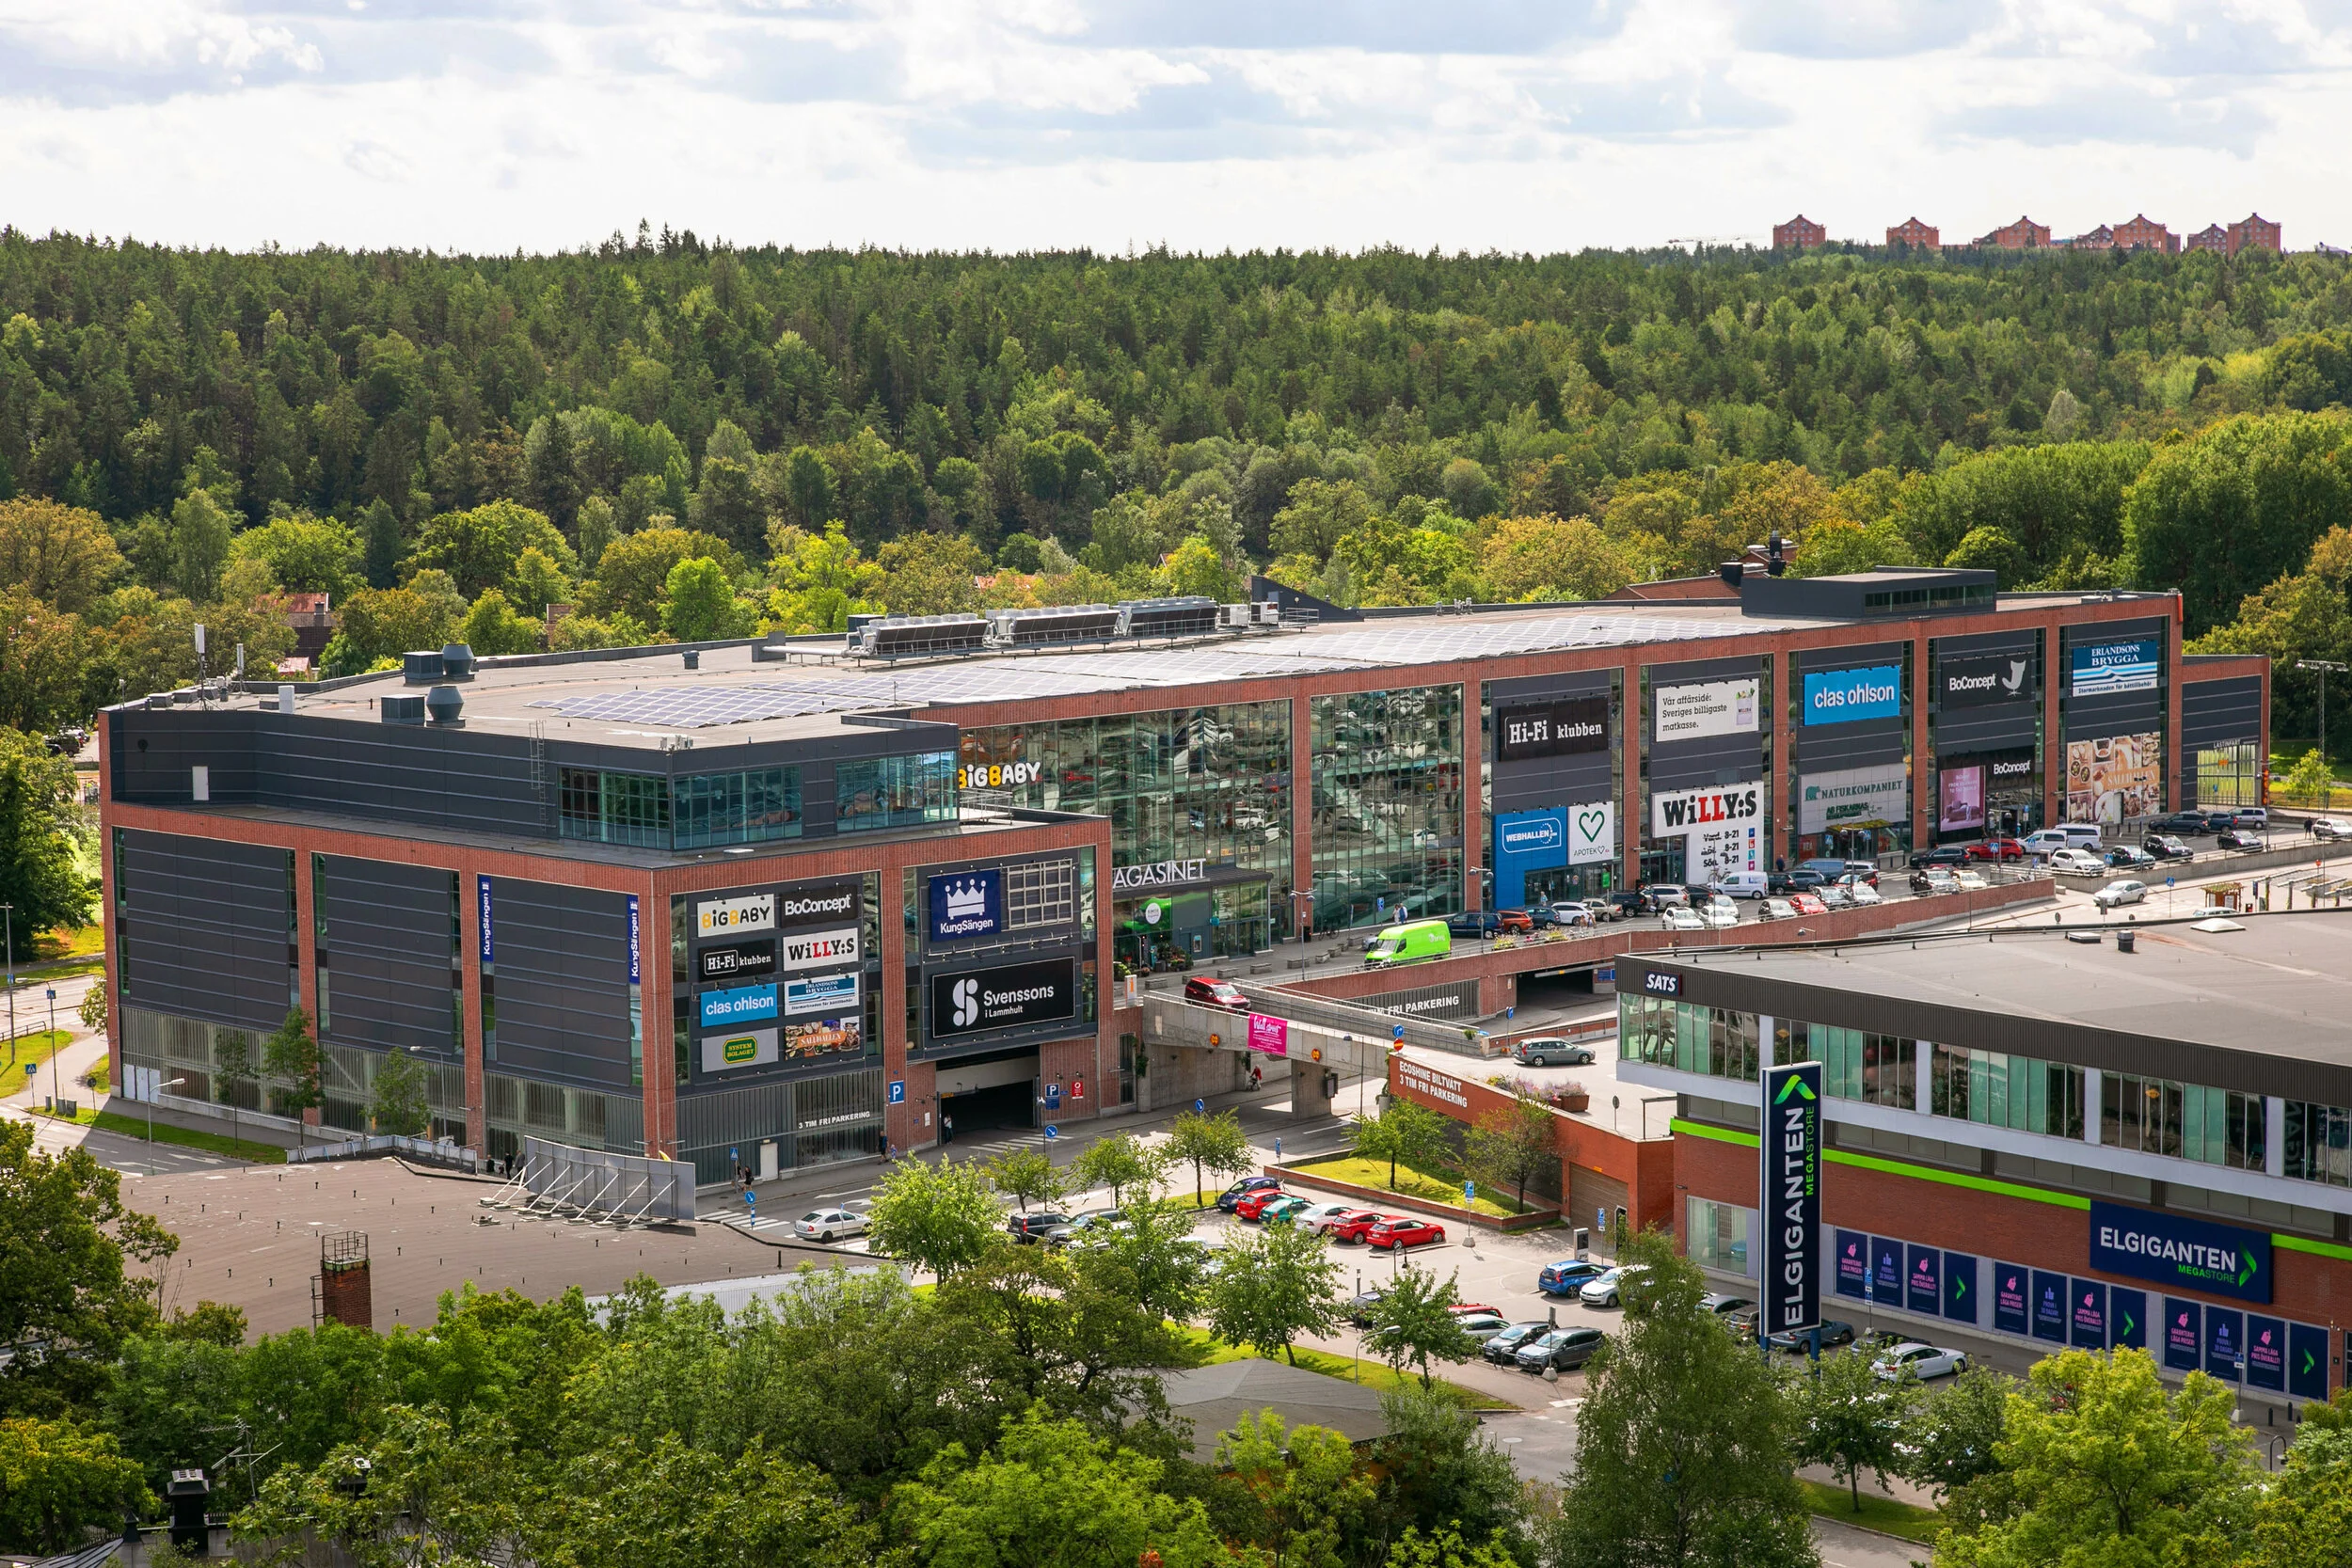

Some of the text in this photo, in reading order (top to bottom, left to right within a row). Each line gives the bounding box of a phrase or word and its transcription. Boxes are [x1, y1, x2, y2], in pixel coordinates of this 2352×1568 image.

[2091, 644, 2140, 657] ERLANDSONS
[2091, 655, 2139, 666] BRYGGA
[1948, 673, 1996, 690] BoConcept
[1662, 693, 1712, 705] Vår affärsidé:
[1814, 683, 1895, 708] clas ohlson
[1662, 704, 1727, 718] Sveriges billigaste
[1509, 720, 1602, 744] Hi-Fi klubben
[1662, 721, 1699, 732] matkasse.
[1994, 760, 2031, 775] BoConcept
[1821, 781, 1902, 800] NATURKOMPANIET
[1662, 790, 1757, 828] WiLLY:S
[1505, 830, 1549, 843] WEBHALLEN
[1724, 829, 1740, 839] 8-21
[1573, 847, 1597, 857] APOTEK
[1724, 842, 1740, 851] 8-21
[1112, 858, 1207, 889] AGASINET
[785, 894, 851, 916] BoConcept
[940, 919, 993, 934] KungSängen
[788, 937, 855, 961] WiLLY:S
[707, 954, 771, 971] Hi-Fi klubben
[805, 980, 838, 989] ERLANDSONS
[805, 986, 838, 994] BRYGGA
[1645, 974, 1677, 992] SATS
[983, 986, 1055, 1006] Svenssons
[1405, 995, 1459, 1013] PARKERING
[706, 995, 774, 1016] clas ohlson
[985, 1006, 1024, 1018] i Lammhult
[726, 1049, 754, 1058] BOLAGET
[727, 1042, 753, 1051] SYSTEM
[1399, 1061, 1430, 1082] ECOSHINE
[893, 1085, 901, 1101] P
[1049, 1085, 1057, 1096] P
[1399, 1074, 1468, 1108] 3 TIM FRI PARKERING
[831, 1111, 870, 1124] PARKERING
[1805, 1105, 1815, 1196] MEGASTORE
[1784, 1106, 1804, 1326] ELGIGANTEN
[2100, 1226, 2235, 1273] ELGIGANTEN
[2178, 1264, 2235, 1284] MEGASTORE
